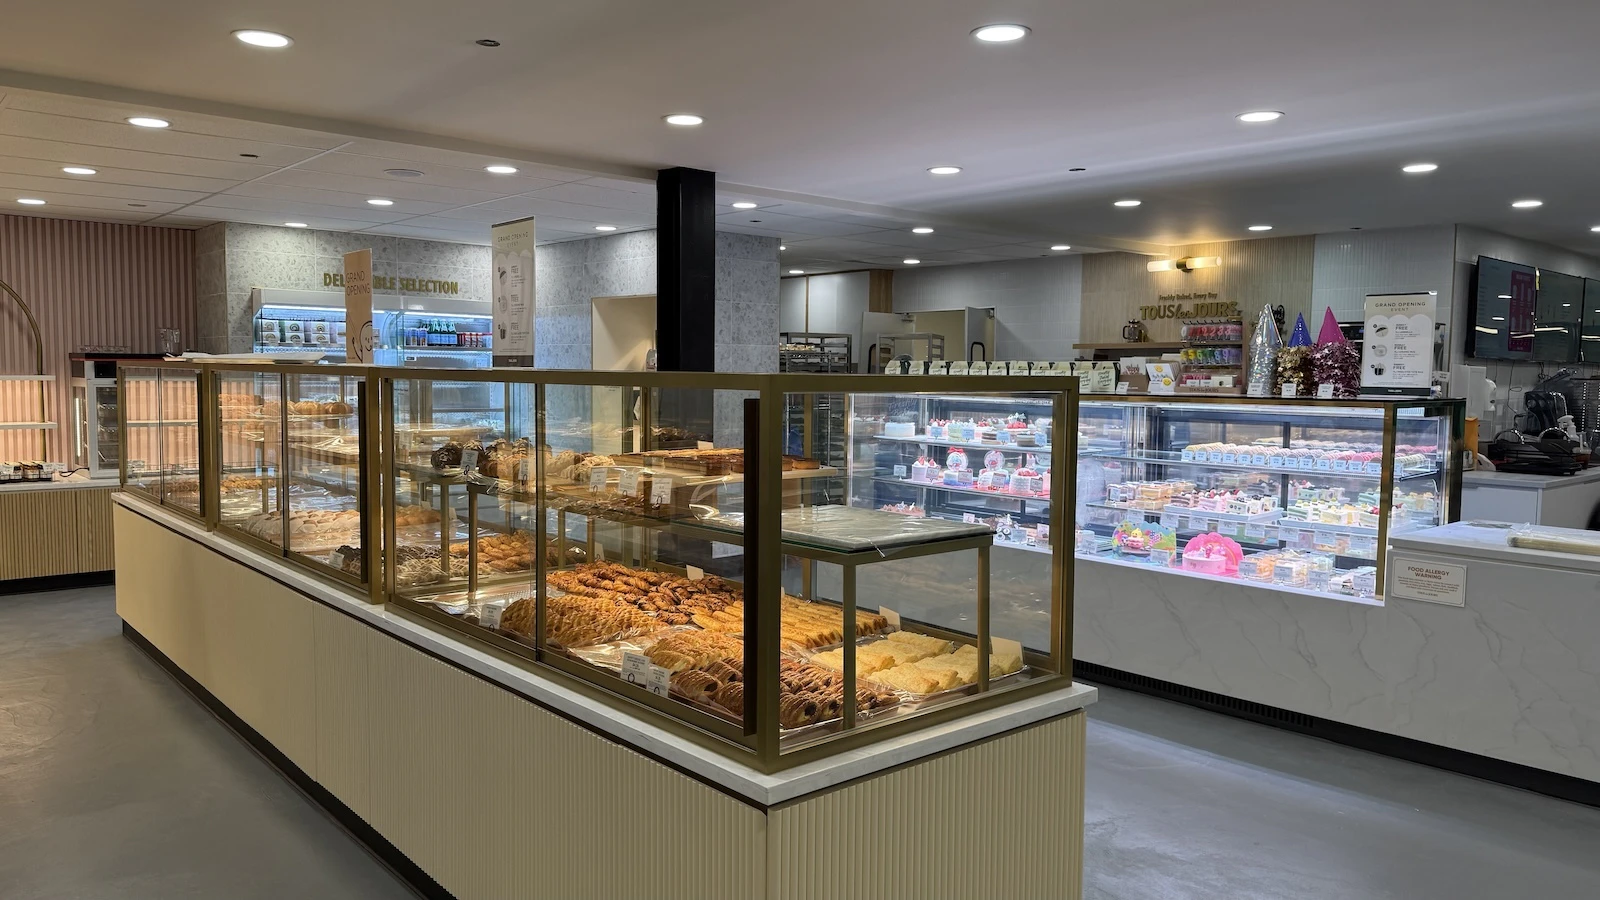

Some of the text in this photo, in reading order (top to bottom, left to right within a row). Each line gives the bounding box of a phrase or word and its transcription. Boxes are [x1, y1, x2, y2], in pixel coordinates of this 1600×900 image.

[345, 270, 365, 284] GRAND
[346, 282, 371, 296] OPENING
[399, 276, 459, 295] SELECTION
[1140, 301, 1238, 320] TOUS les JOURS
[1414, 572, 1442, 580] WARNING
[1425, 568, 1450, 576] ALLERGY
